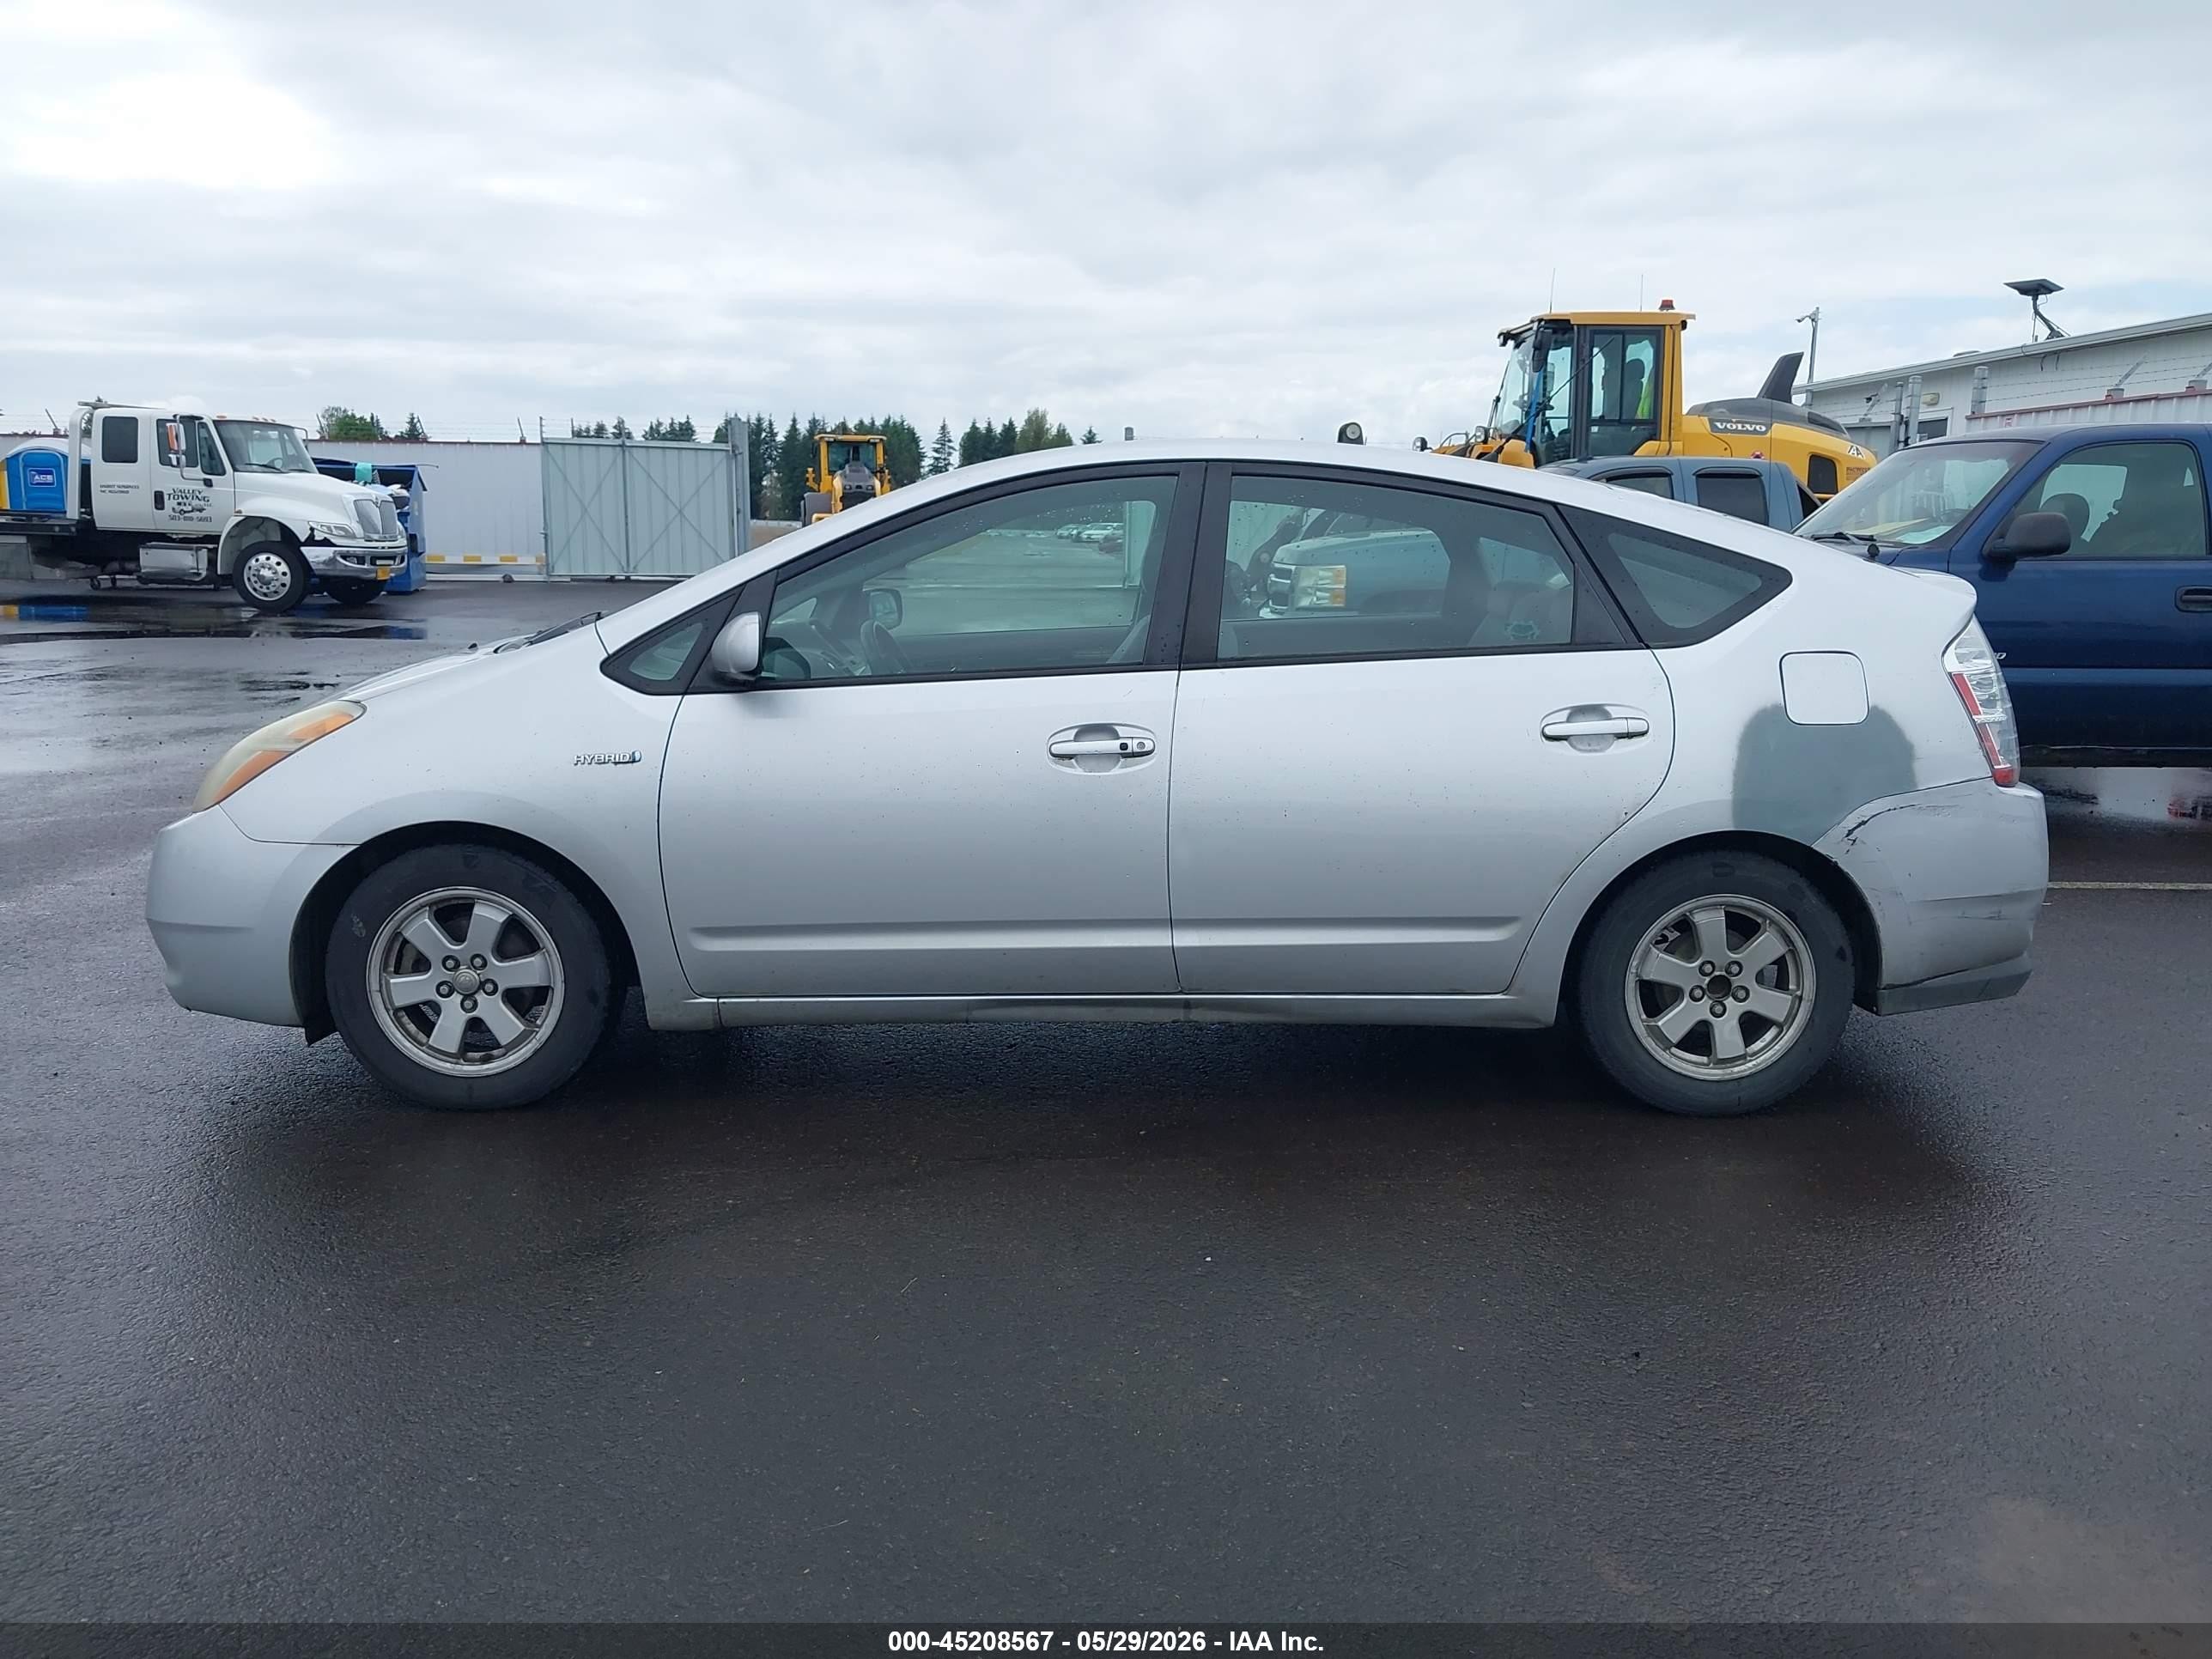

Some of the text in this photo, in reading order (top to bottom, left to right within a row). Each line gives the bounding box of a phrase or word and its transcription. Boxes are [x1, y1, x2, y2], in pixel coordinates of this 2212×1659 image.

[1714, 422, 1766, 432] VOLVO
[167, 493, 210, 502] TOWING
[573, 753, 631, 765] HYBRID
